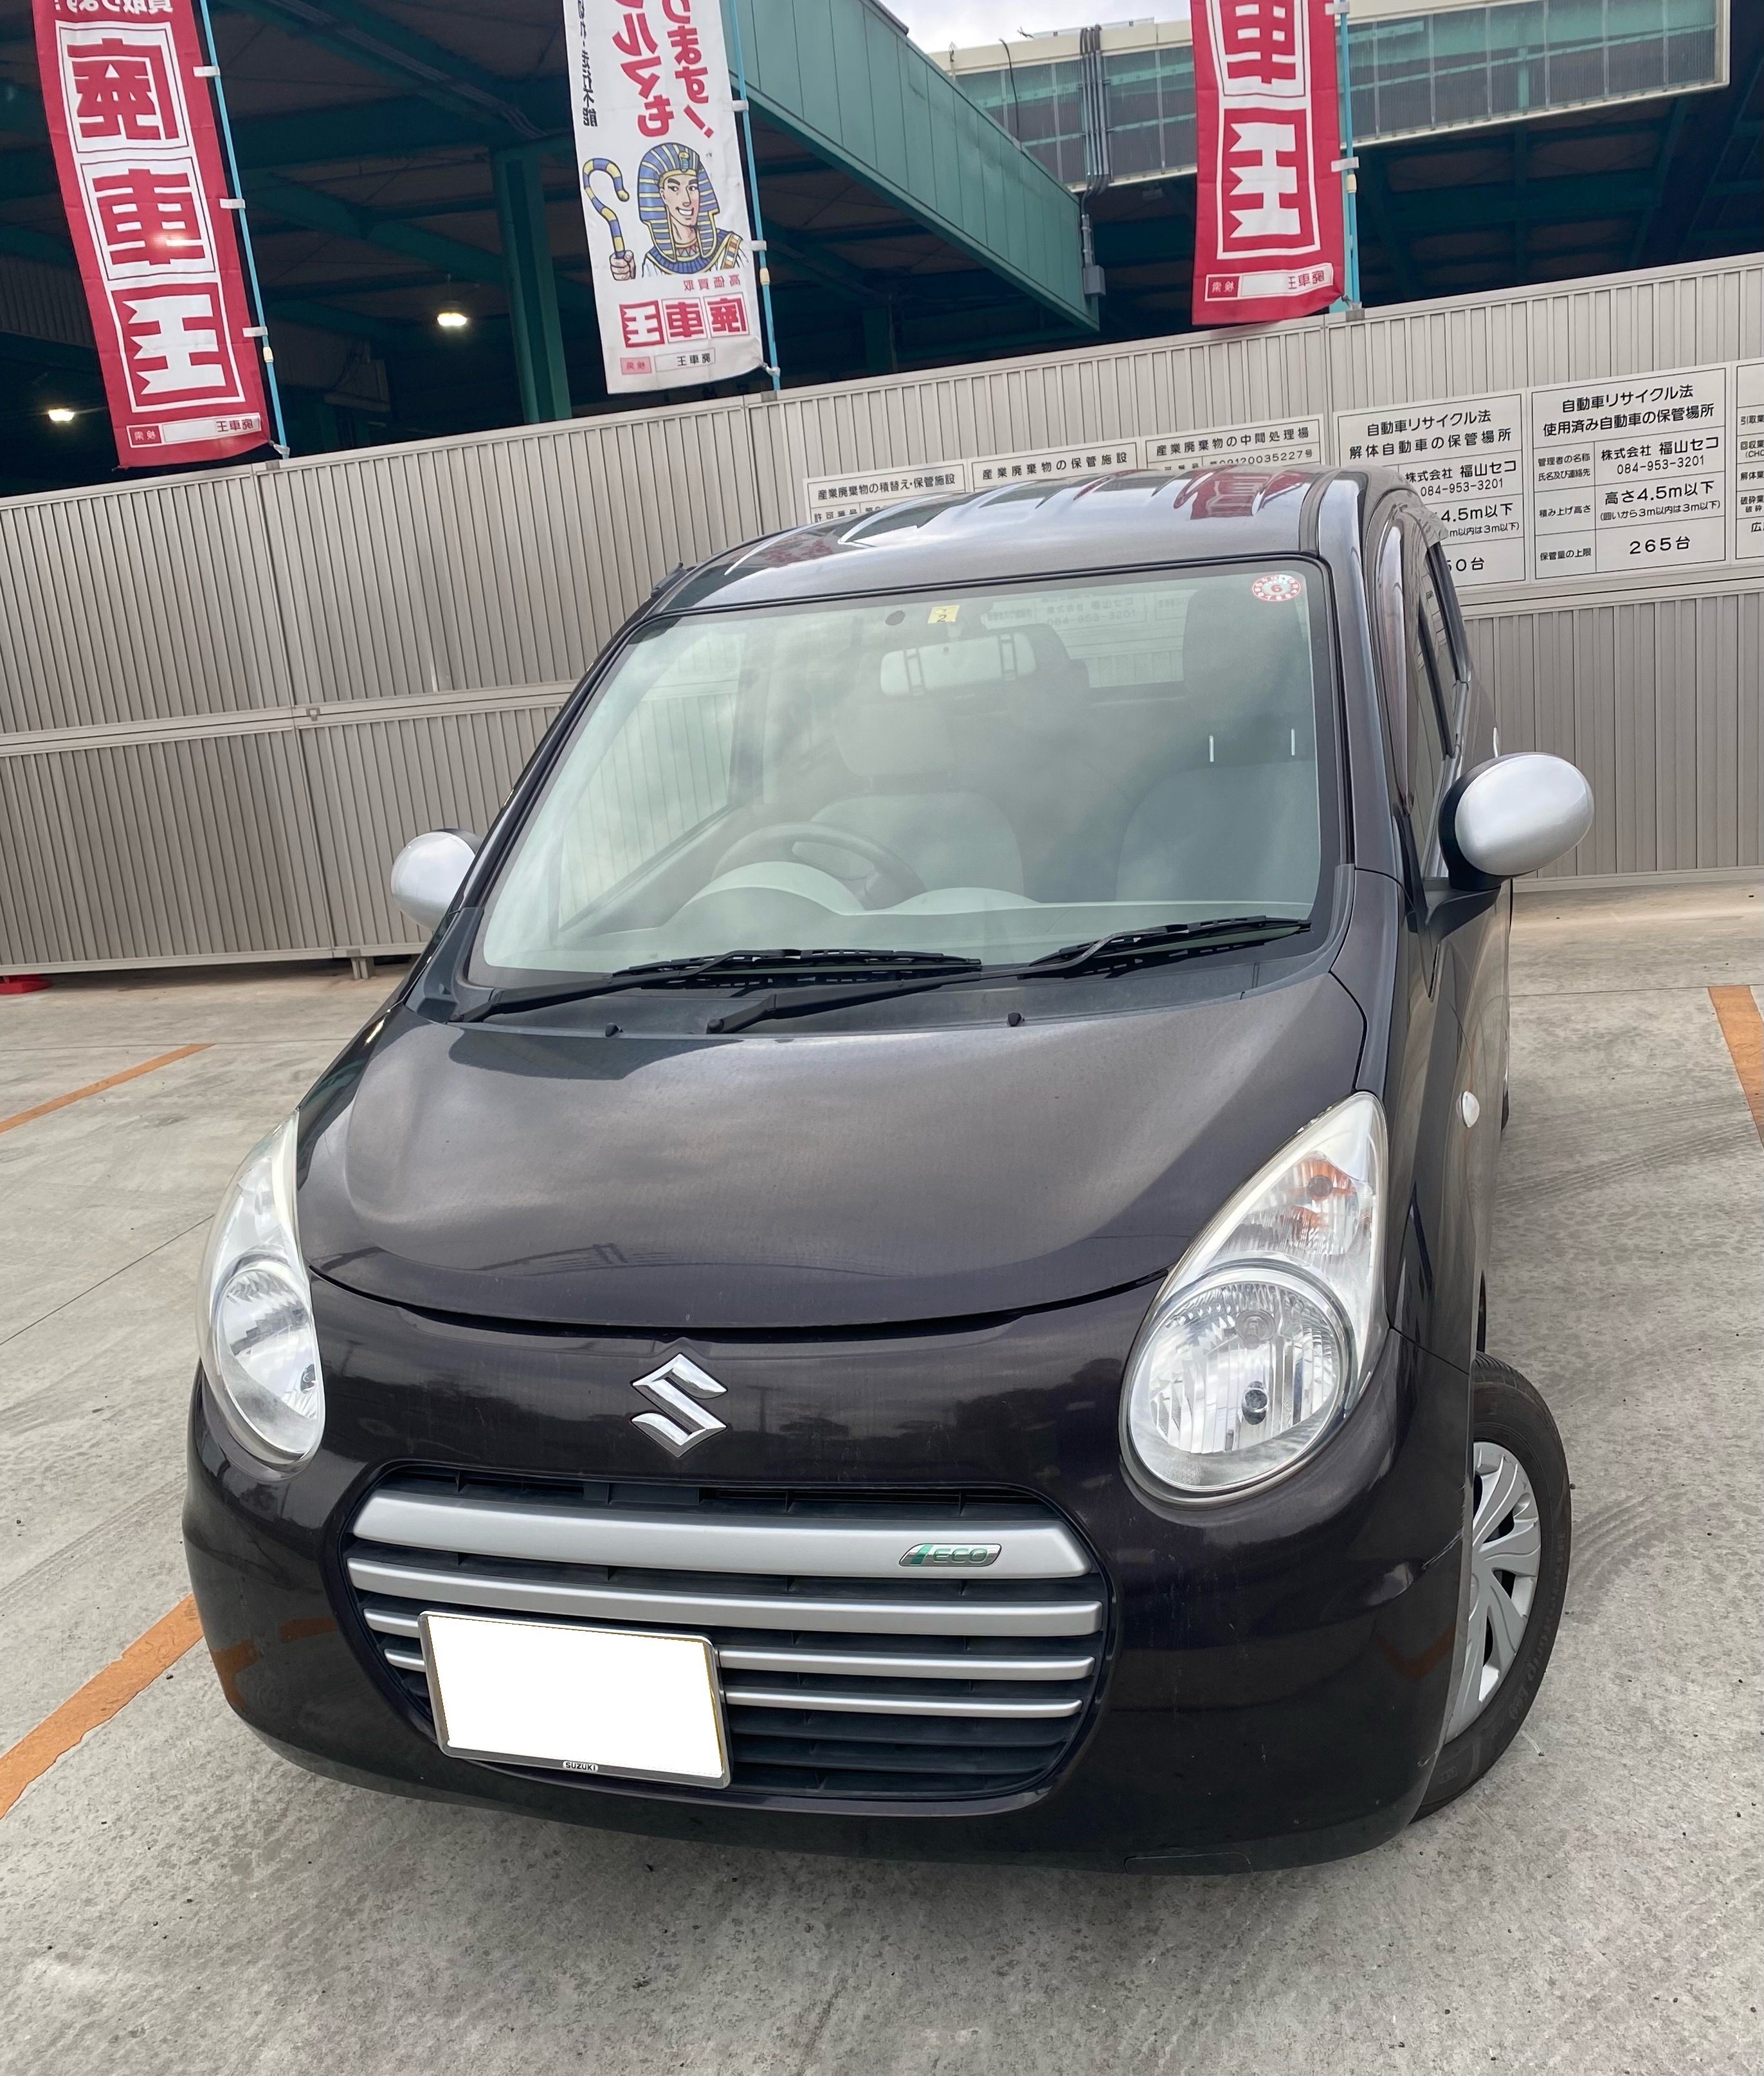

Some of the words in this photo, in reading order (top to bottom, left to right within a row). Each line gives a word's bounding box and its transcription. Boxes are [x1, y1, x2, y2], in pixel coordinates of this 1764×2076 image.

[1562, 384, 1693, 413] 自動車リサイクル法
[1367, 410, 1491, 437] 自動車リサイクル法
[1543, 403, 1714, 437] 使用済み自動車の保管場所
[1156, 427, 1309, 456] 産業廃棄物の中間処理場
[1350, 428, 1511, 459] 解体自動車の保管場所
[1601, 445, 1651, 461] 株式会社
[1659, 437, 1719, 455] 福山セコ
[983, 452, 1127, 480] 産業廃棄物の保管施設
[1538, 453, 1590, 467] 管理者の名称
[1617, 455, 1704, 475] 084-953-3201
[1405, 468, 1453, 483] 株式会社
[1460, 460, 1516, 478] 福山セコ
[1538, 468, 1590, 482] 氏名及び連絡先
[1421, 478, 1504, 496] 084-953-3201
[1605, 480, 1714, 505] 高さ4.5m以下
[1539, 505, 1591, 518] 積み上げ高さ
[1751, 522, 1764, 533] 広
[1540, 547, 1592, 561] 保管量の上限
[1629, 536, 1690, 554] 265台
[937, 614, 947, 623] 2
[932, 1548, 989, 1563] ECO
[565, 1762, 596, 1771] SUZUKI
